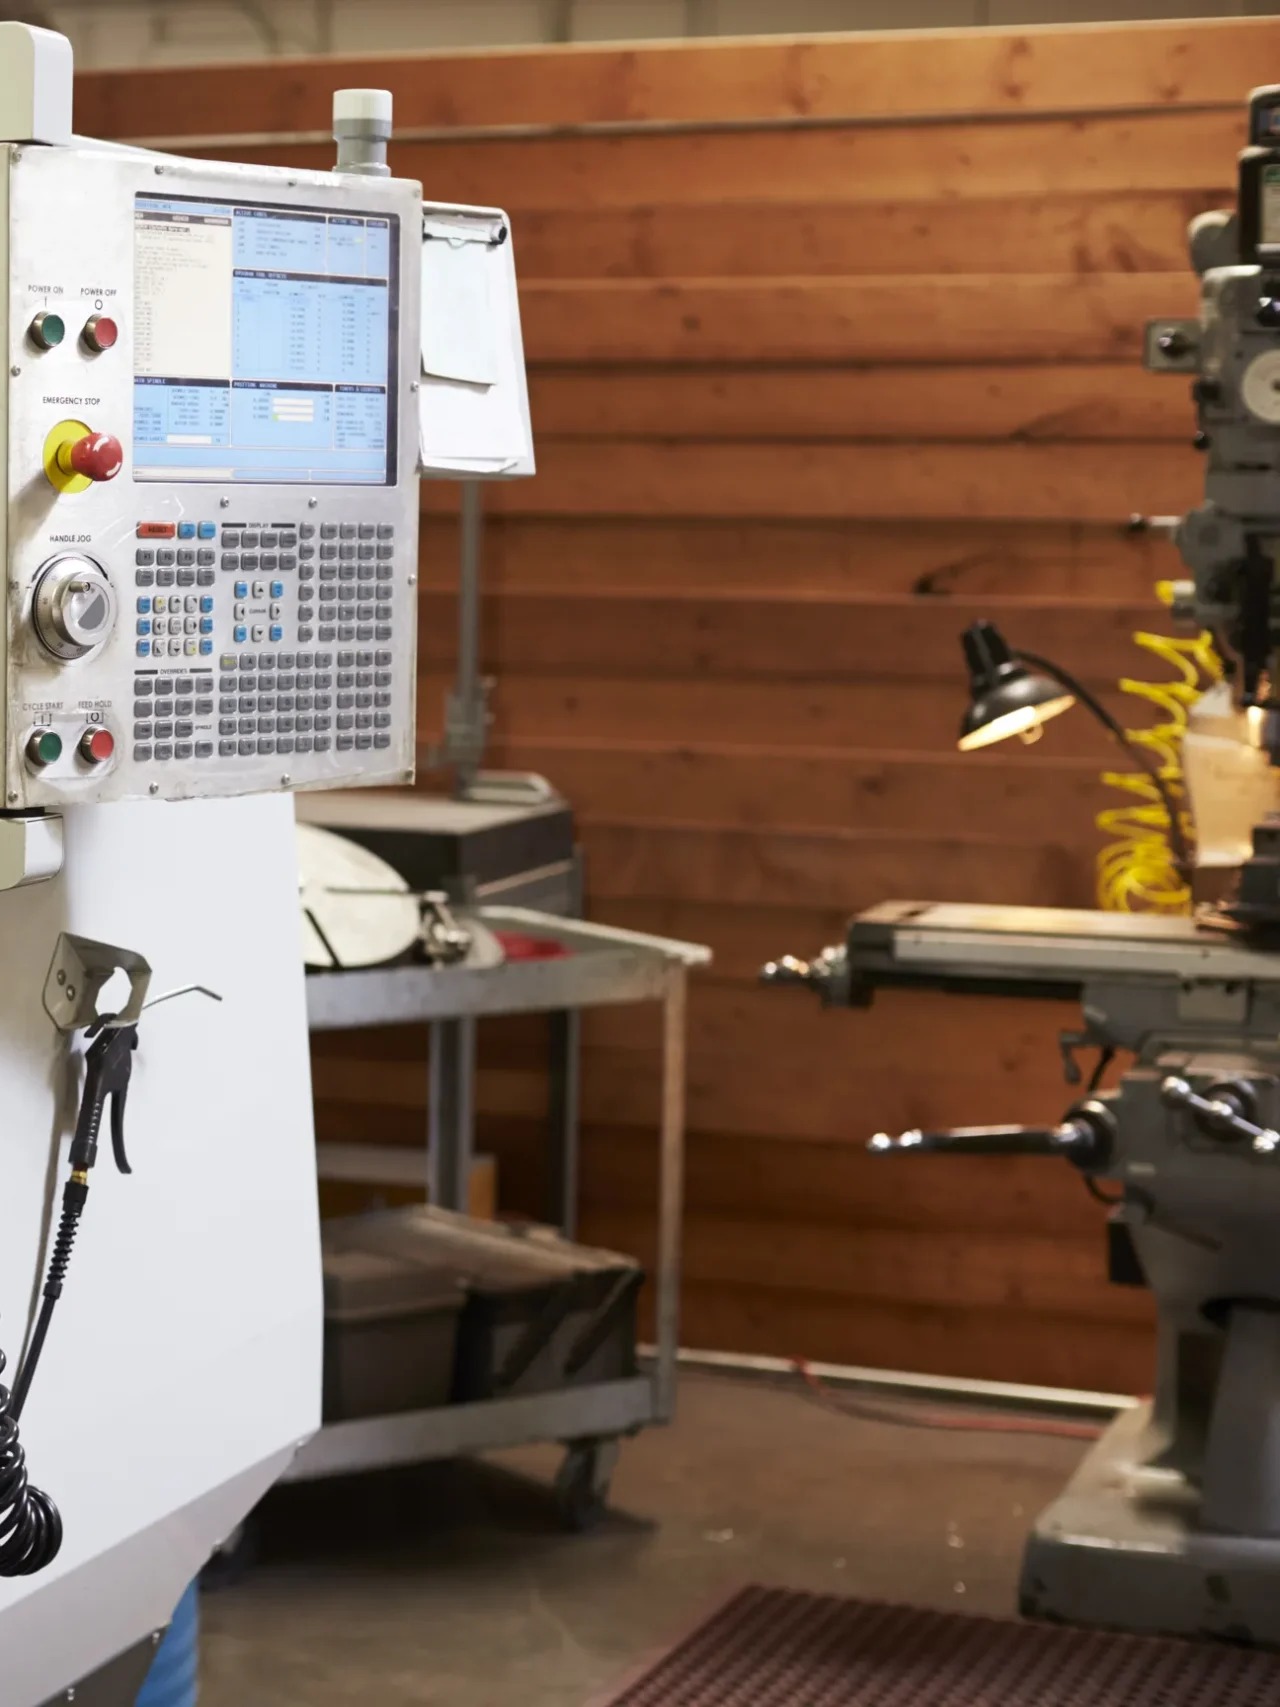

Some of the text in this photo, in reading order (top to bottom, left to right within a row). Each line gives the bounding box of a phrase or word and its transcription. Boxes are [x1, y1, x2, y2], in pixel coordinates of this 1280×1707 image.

[27, 284, 64, 294] POWER ON
[80, 287, 117, 297] POWER OFF
[42, 396, 101, 406] EMERGENCY STOP
[148, 525, 168, 534] RESET
[49, 534, 92, 543] HANDLE JOG
[22, 701, 64, 711] CYCLE START
[78, 699, 113, 709] FEED HOLD
